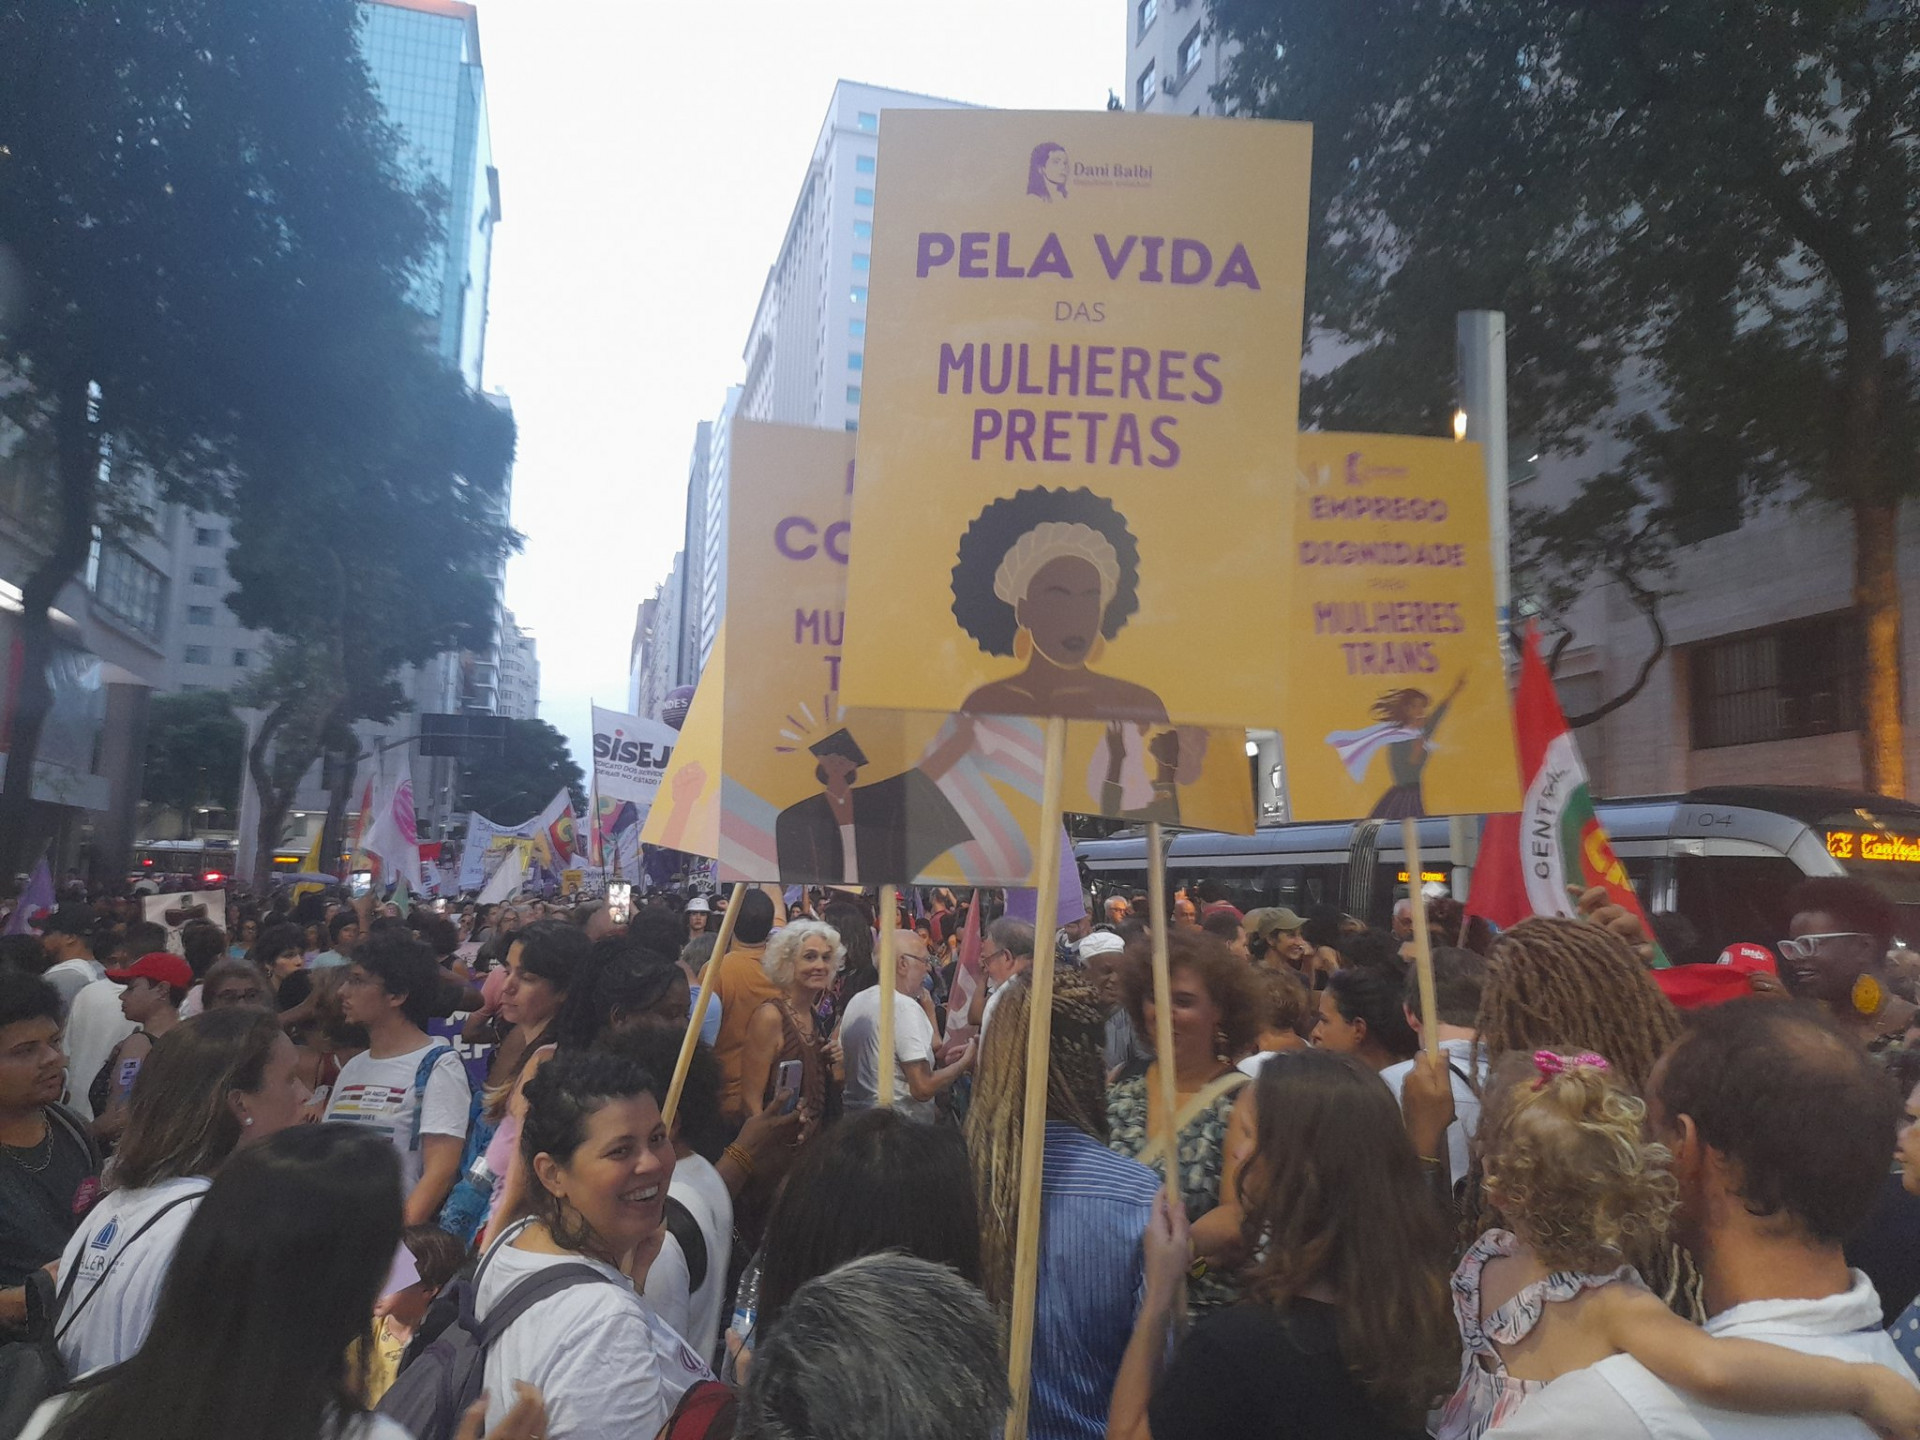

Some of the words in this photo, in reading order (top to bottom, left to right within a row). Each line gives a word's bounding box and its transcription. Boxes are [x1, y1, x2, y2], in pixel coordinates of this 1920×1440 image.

[1074, 162, 1109, 177] Dani
[1114, 163, 1153, 179] Balbi
[915, 232, 1074, 279] PELA
[1093, 234, 1262, 290] VIDA
[1055, 301, 1106, 323] DAS
[937, 343, 1223, 405] MULHERES
[971, 408, 1181, 469] PRETAS
[1310, 495, 1448, 523] EMPREGO
[1299, 541, 1466, 568] DIGNIDADE
[1313, 602, 1465, 635] MULHERES
[1341, 641, 1440, 675] TRANS
